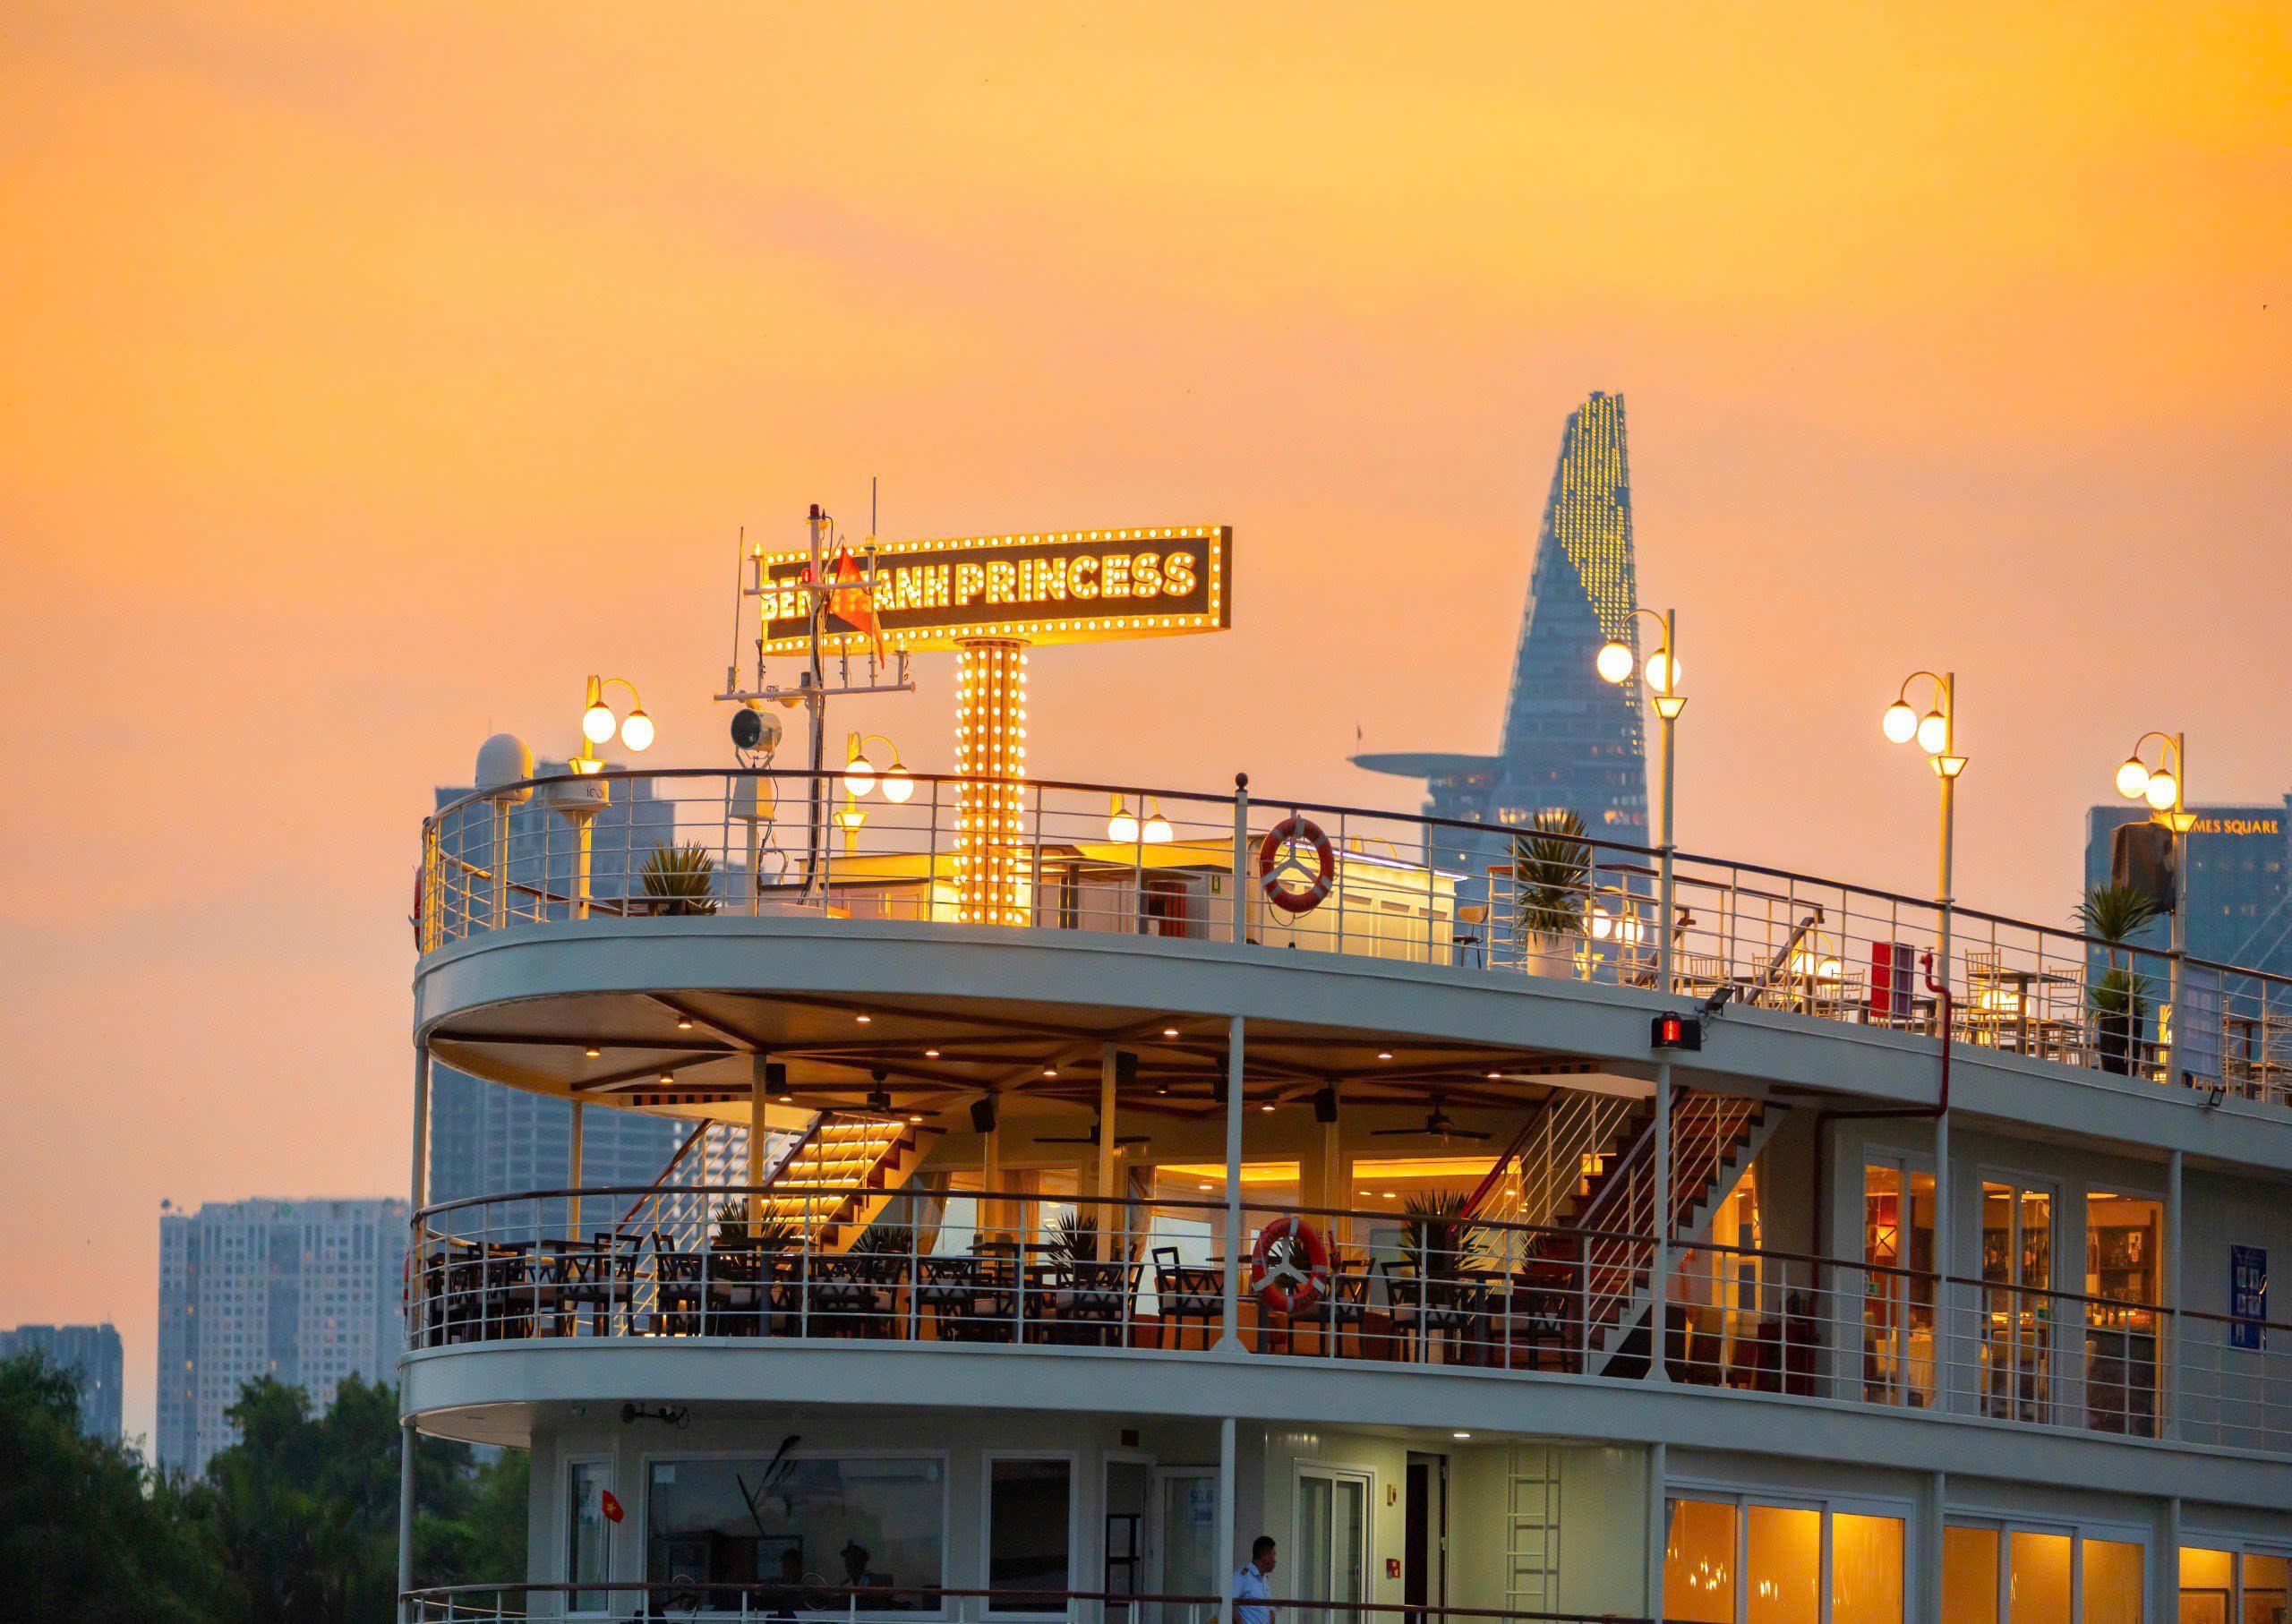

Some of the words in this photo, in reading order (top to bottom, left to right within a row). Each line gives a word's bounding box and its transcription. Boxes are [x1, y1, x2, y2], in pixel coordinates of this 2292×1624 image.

[954, 551, 1197, 606] PRINCESS
[2190, 819, 2221, 833] MES
[2223, 818, 2279, 835] SQUARE
